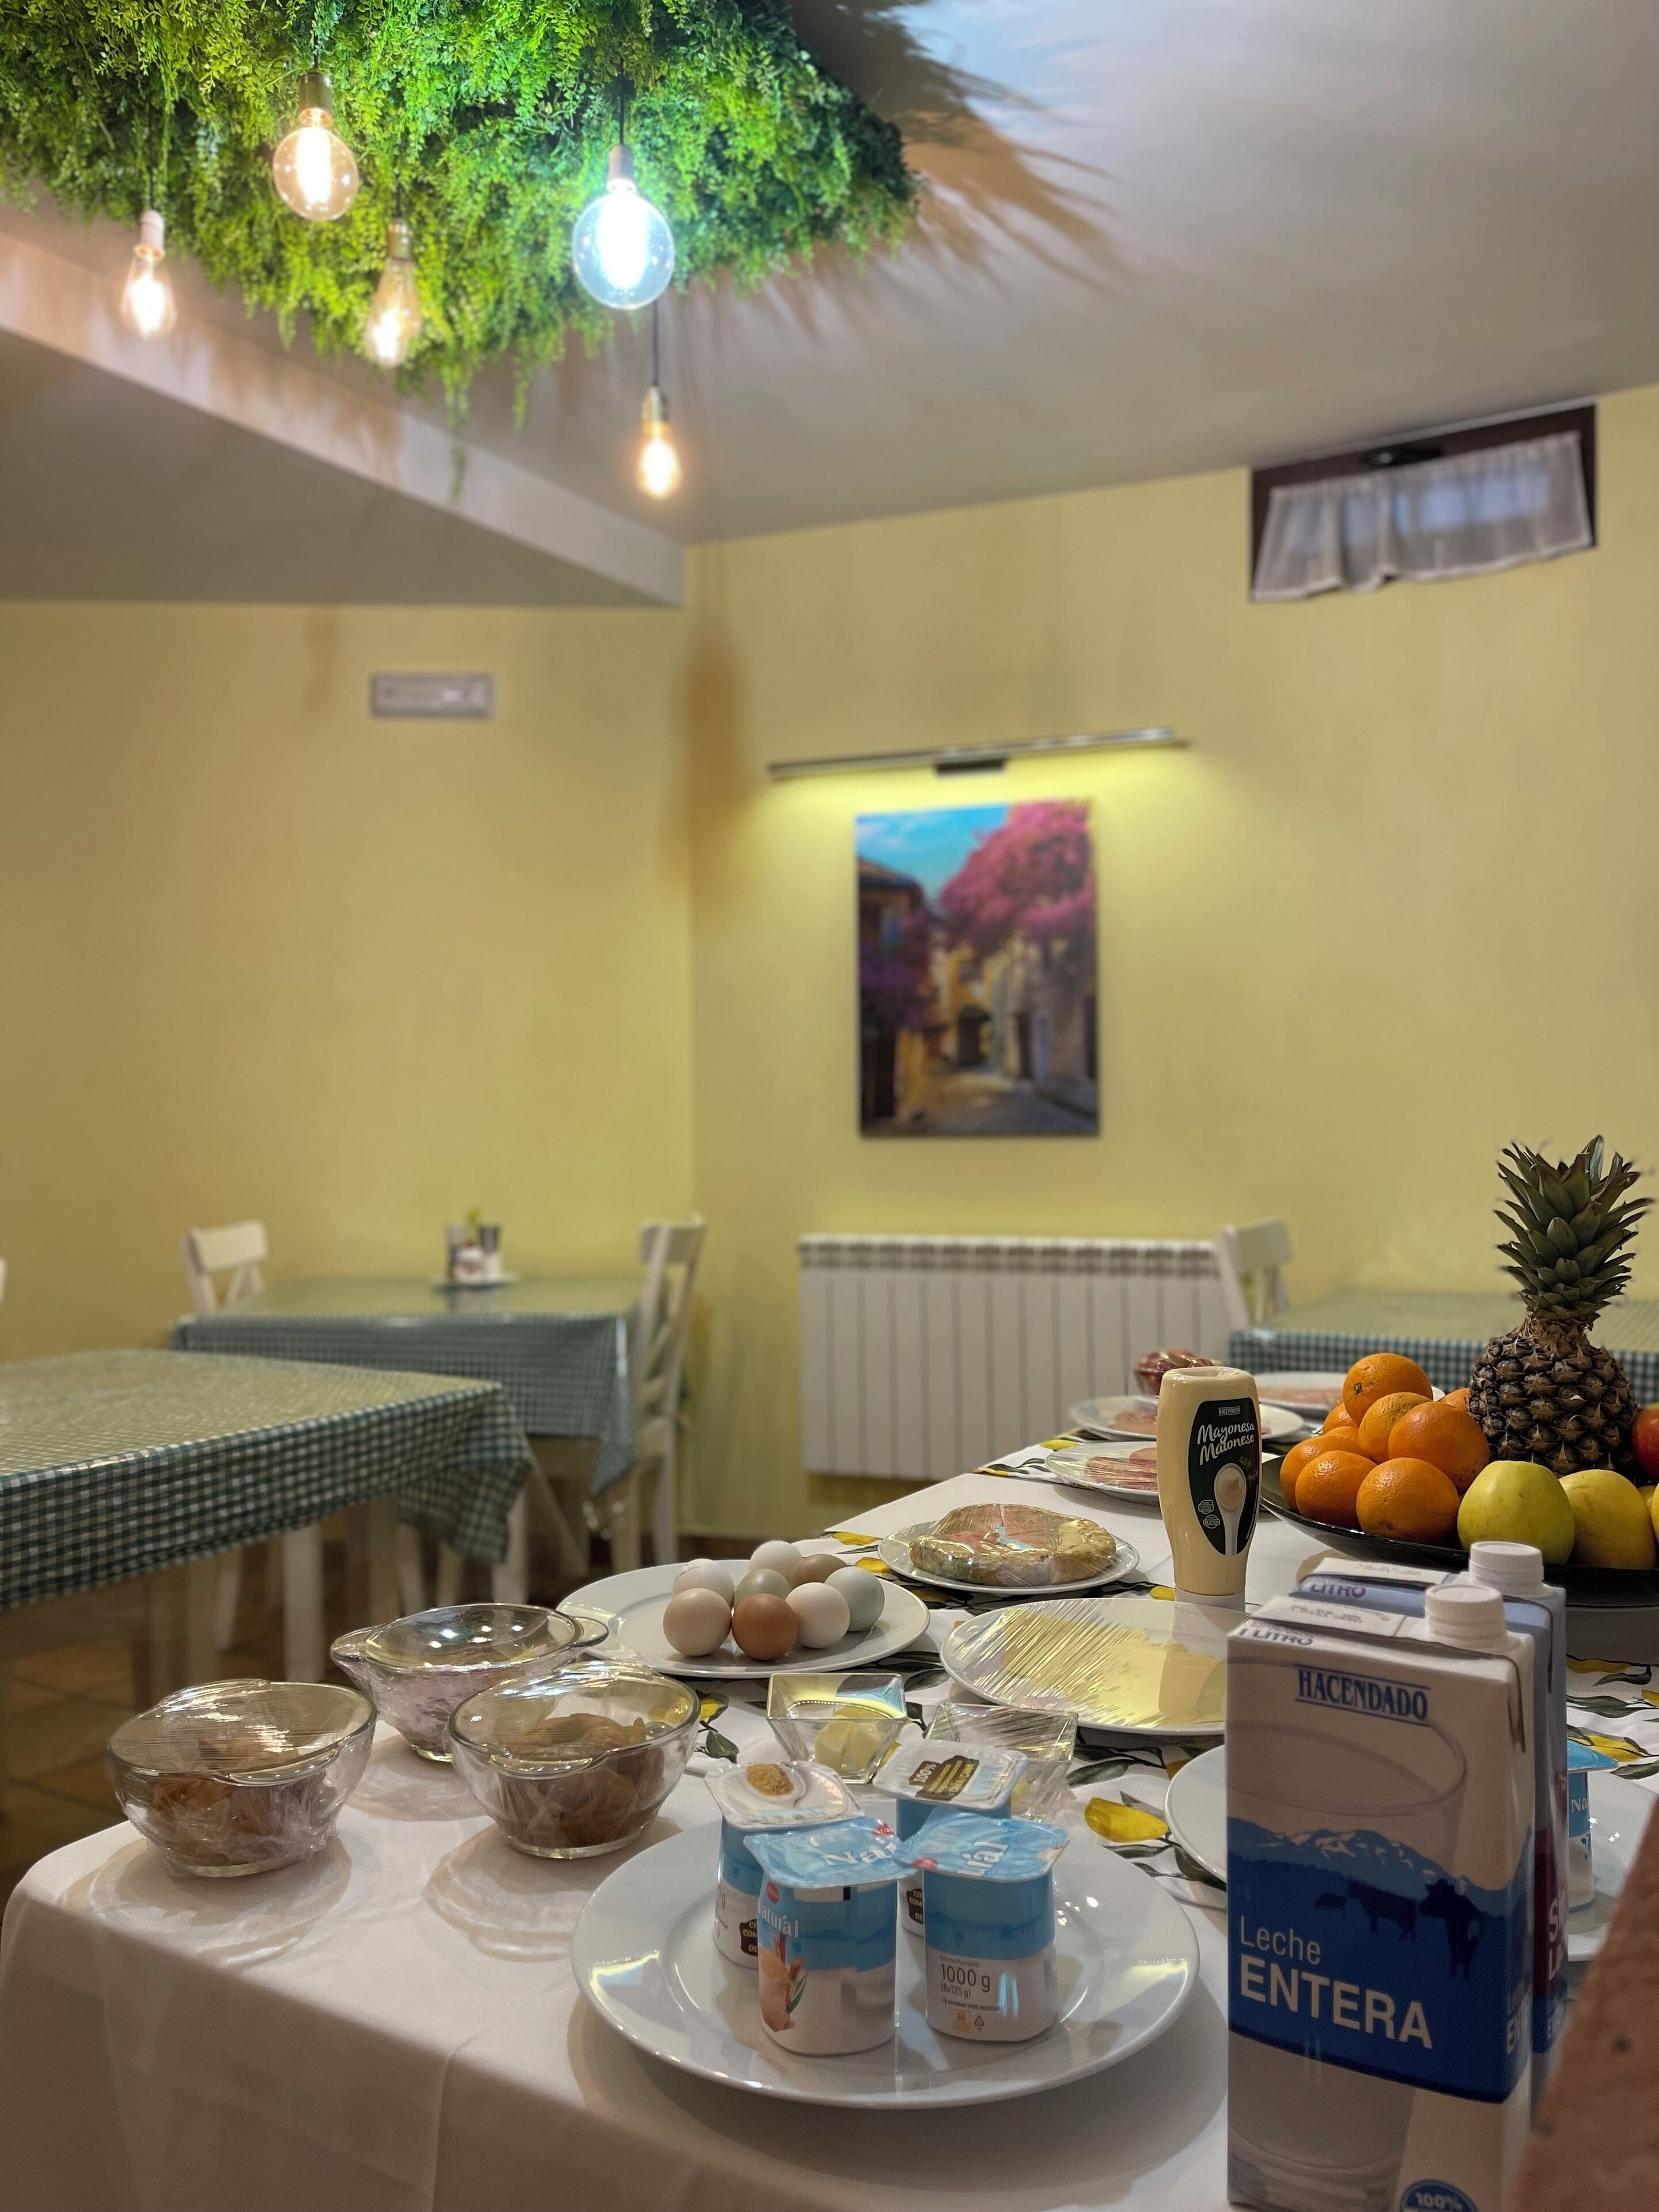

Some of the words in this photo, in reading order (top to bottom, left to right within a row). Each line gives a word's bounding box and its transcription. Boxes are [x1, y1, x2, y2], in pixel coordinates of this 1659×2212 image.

[1197, 1422, 1256, 1445] Mayonesa
[1252, 1628, 1314, 1646] LITRO
[1298, 1669, 1429, 1721] HACENDADO
[914, 1763, 937, 1783] 100%
[1240, 1915, 1321, 1965] Leche
[940, 1964, 976, 1987] 1000
[981, 1975, 990, 1993] g
[941, 1982, 963, 1996] (8x125
[964, 1987, 971, 1999] g)
[1240, 1953, 1434, 2050] ENTERA
[1415, 2192, 1463, 2212] 100%
